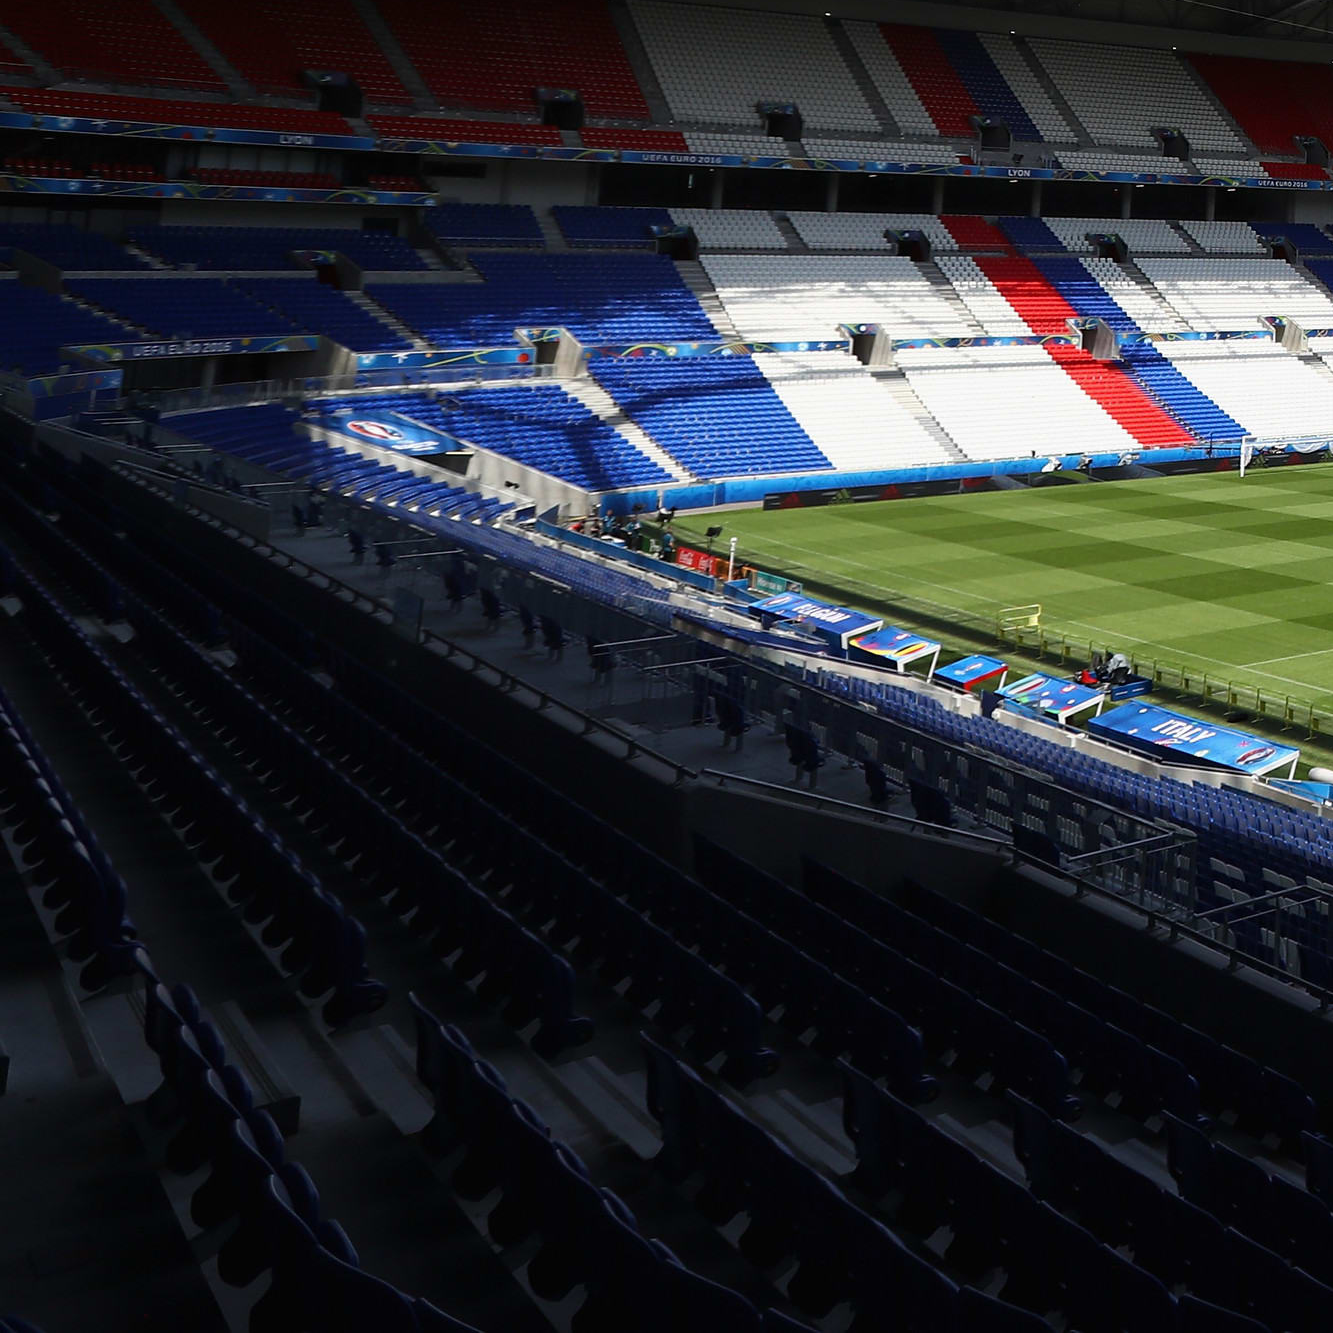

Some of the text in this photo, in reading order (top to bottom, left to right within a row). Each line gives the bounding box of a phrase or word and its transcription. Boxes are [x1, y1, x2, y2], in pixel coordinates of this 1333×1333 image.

[642, 154, 722, 164] UEFA EURO 2016
[1008, 169, 1031, 177] LYON
[1151, 718, 1217, 743] ITALY
